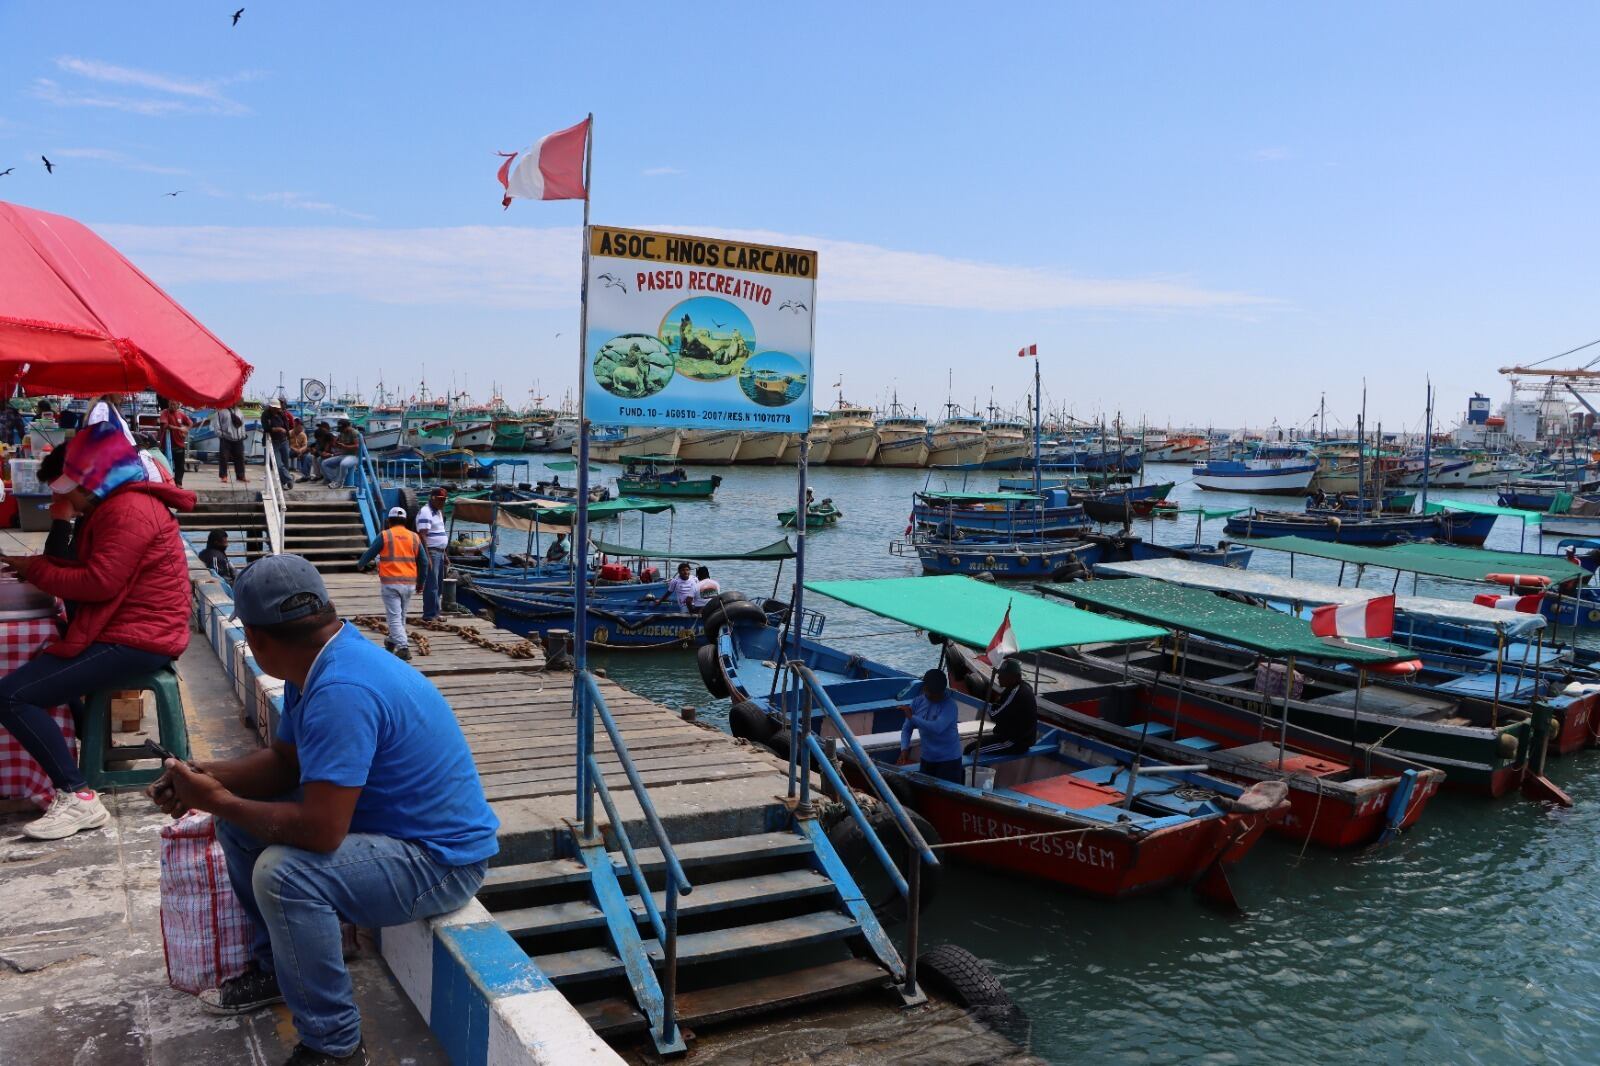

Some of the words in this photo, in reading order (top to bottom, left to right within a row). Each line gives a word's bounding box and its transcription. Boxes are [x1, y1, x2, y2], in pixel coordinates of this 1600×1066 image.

[599, 231, 661, 259] ASOC.
[666, 239, 719, 266] HNOS
[723, 245, 810, 276] CARCAMO
[636, 270, 683, 292] PASEO
[688, 270, 772, 306] RECREATIVO
[619, 406, 646, 417] FUND.
[665, 409, 696, 418] AGOSTO
[753, 413, 791, 423] 11070778
